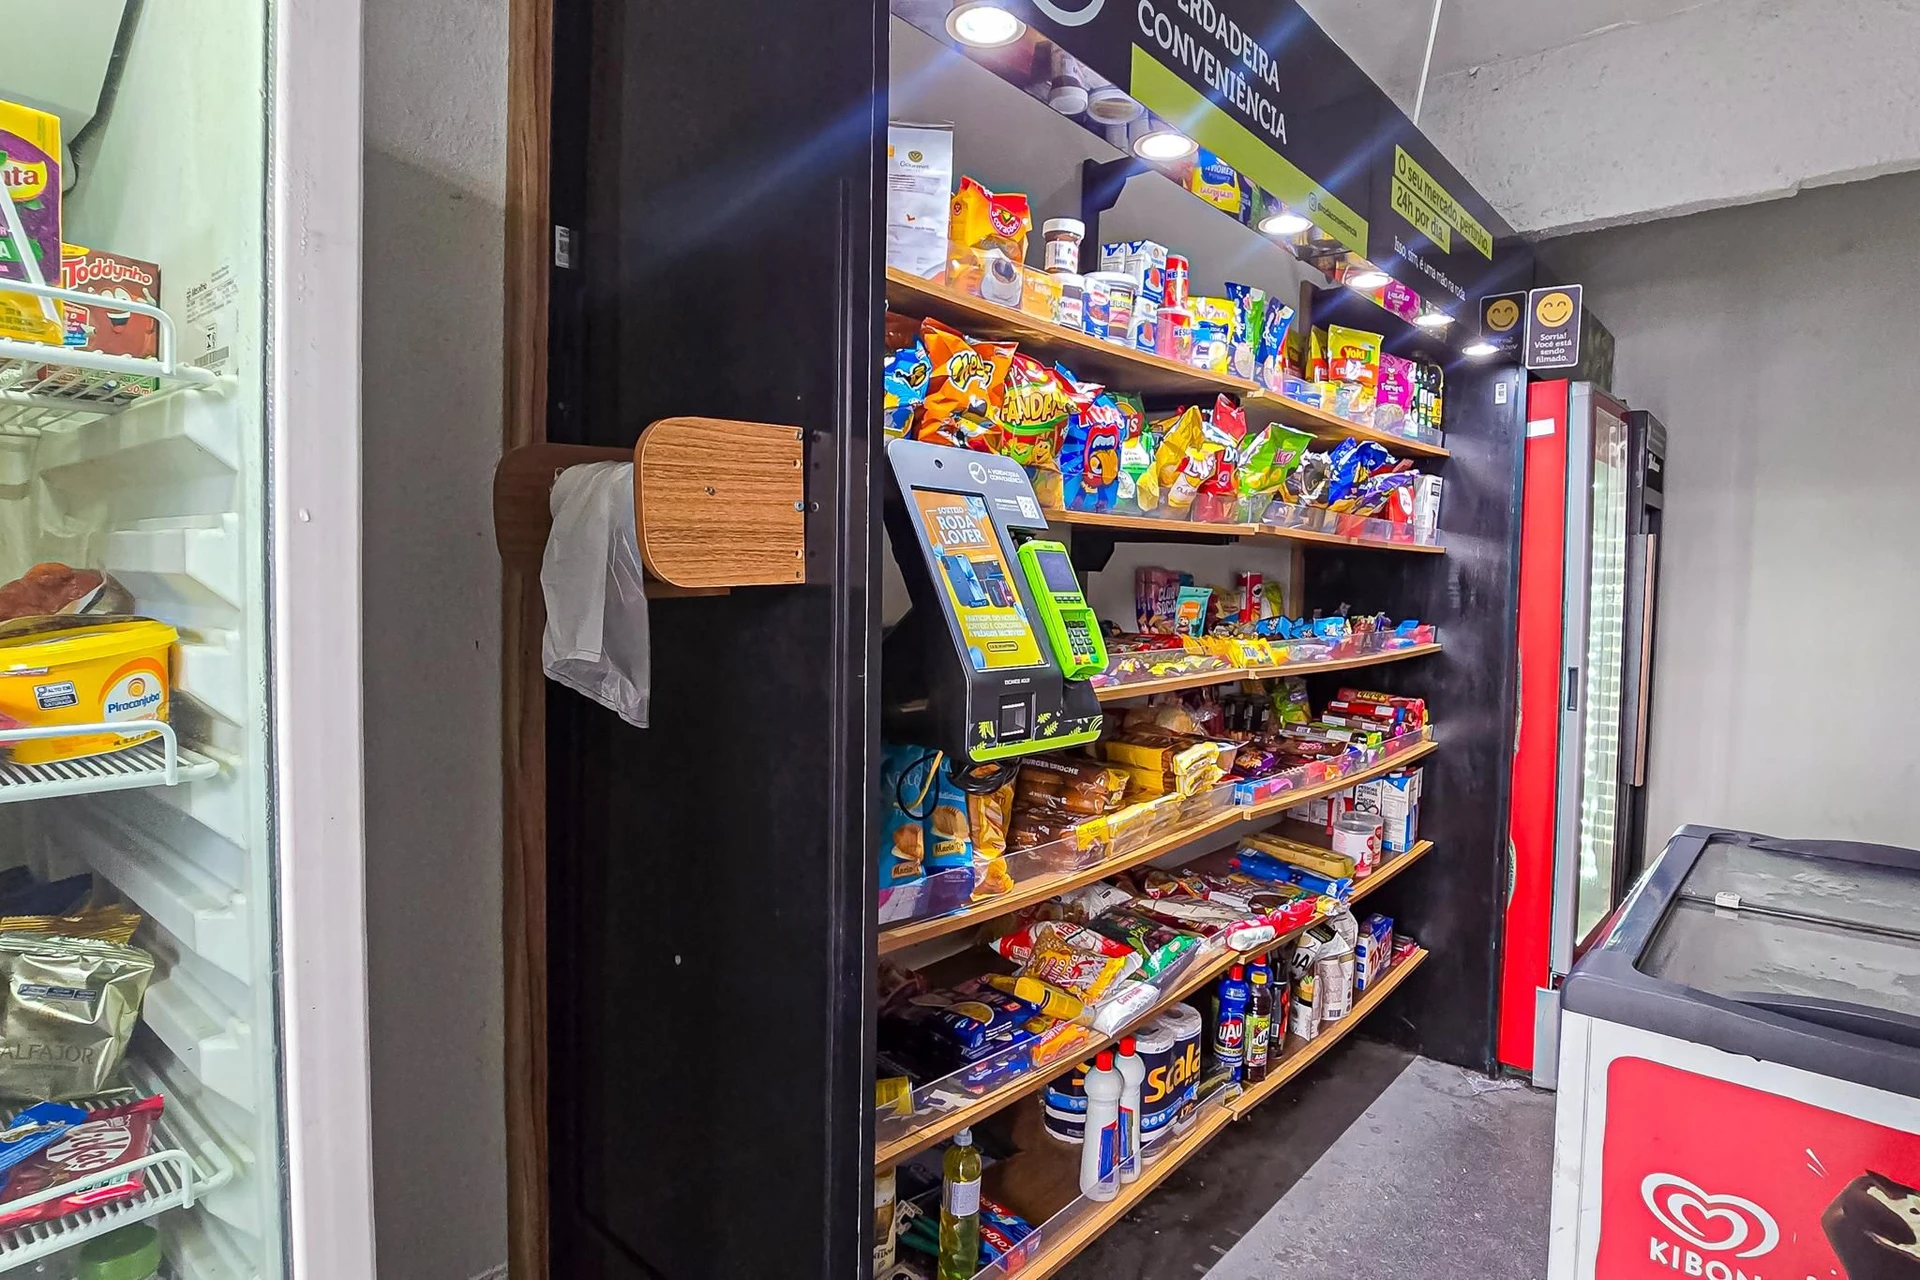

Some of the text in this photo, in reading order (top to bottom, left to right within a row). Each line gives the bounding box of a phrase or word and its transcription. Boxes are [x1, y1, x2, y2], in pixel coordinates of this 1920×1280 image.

[1137, 0, 1288, 145] CONVENIÊNCIA
[1396, 186, 1445, 243] 24h por dia.
[1398, 153, 1489, 256] O seu mercado, pertinho,
[1394, 235, 1407, 261] Isso,
[61, 257, 153, 289] Toddynho
[1534, 338, 1572, 349] Você está
[1540, 332, 1567, 341] Sorria!
[1344, 347, 1366, 359] Yoki
[1535, 355, 1568, 363] filmado.
[936, 515, 976, 531] RODA
[939, 529, 985, 545] LOVER
[107, 692, 161, 714] Piracanjuba
[1218, 1021, 1243, 1041] UAU
[1, 1042, 94, 1065] ALFAJOR
[1144, 1043, 1201, 1104] Scala
